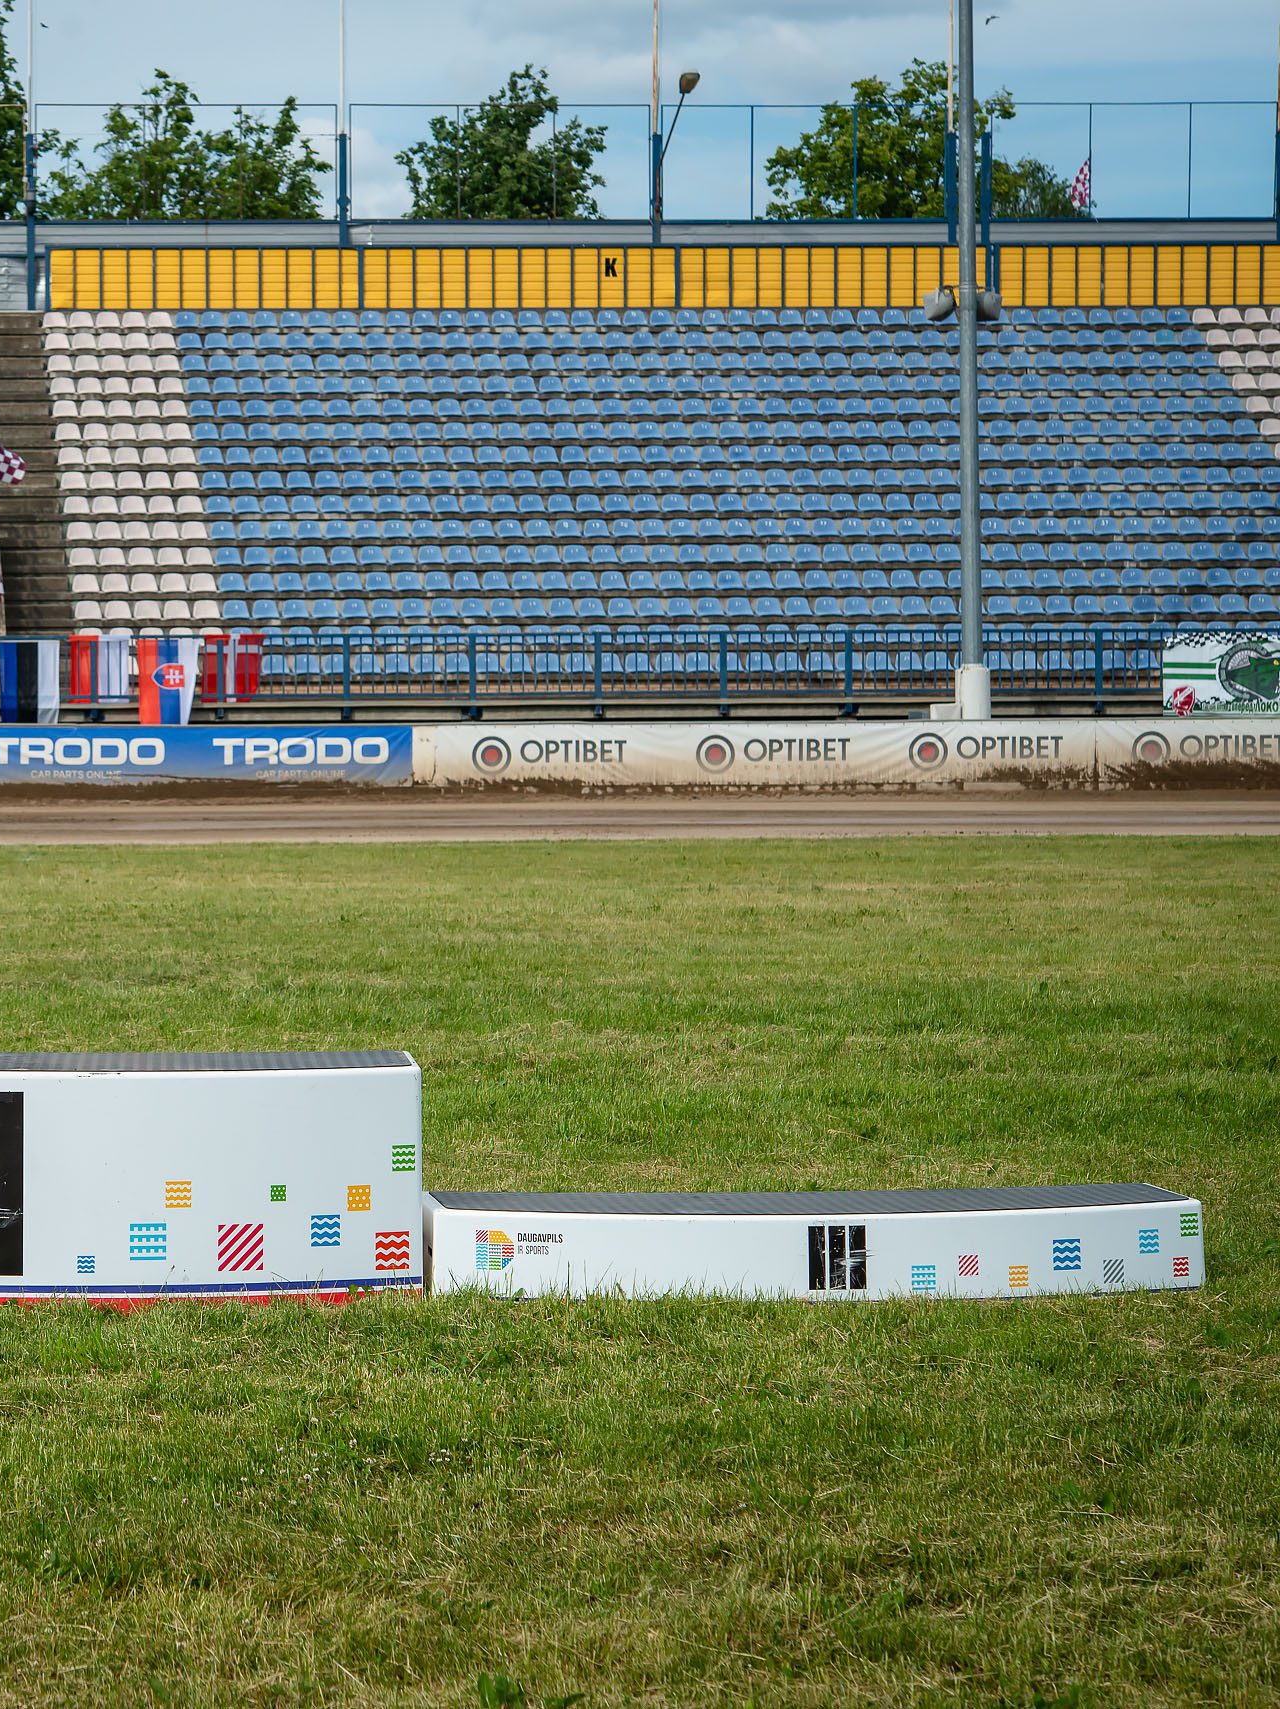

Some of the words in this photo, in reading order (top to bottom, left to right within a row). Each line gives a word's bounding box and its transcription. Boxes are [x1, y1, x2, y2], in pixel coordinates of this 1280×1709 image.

[604, 257, 617, 277] K
[212, 736, 390, 765] TRODO
[520, 739, 627, 763] OPTIBET
[744, 738, 850, 762] OPTIBET
[956, 736, 1063, 759] OPTIBET
[517, 1232, 564, 1244] DAUGAVPILS
[517, 1245, 524, 1255] IR
[525, 1245, 550, 1256] SPORTS
